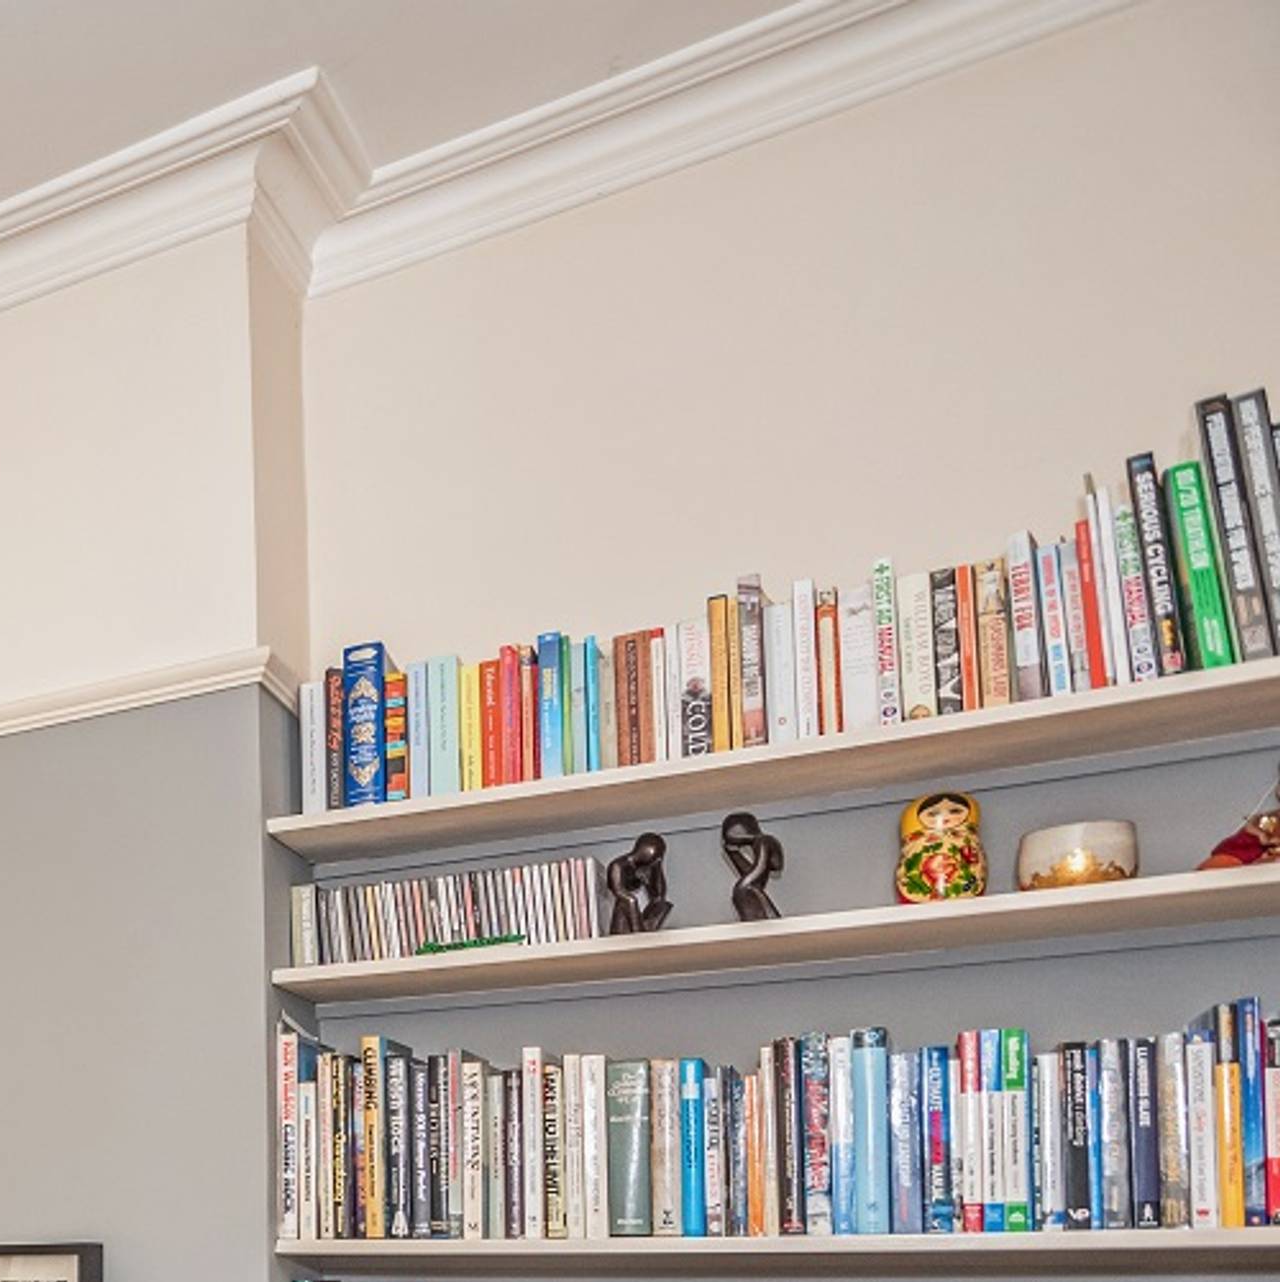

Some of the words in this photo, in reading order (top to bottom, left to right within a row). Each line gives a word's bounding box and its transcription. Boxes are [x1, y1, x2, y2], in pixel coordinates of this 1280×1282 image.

[1134, 471, 1161, 543] SERIOUS
[1146, 543, 1174, 616] CYCLING
[363, 1047, 378, 1110] CLIMBING
